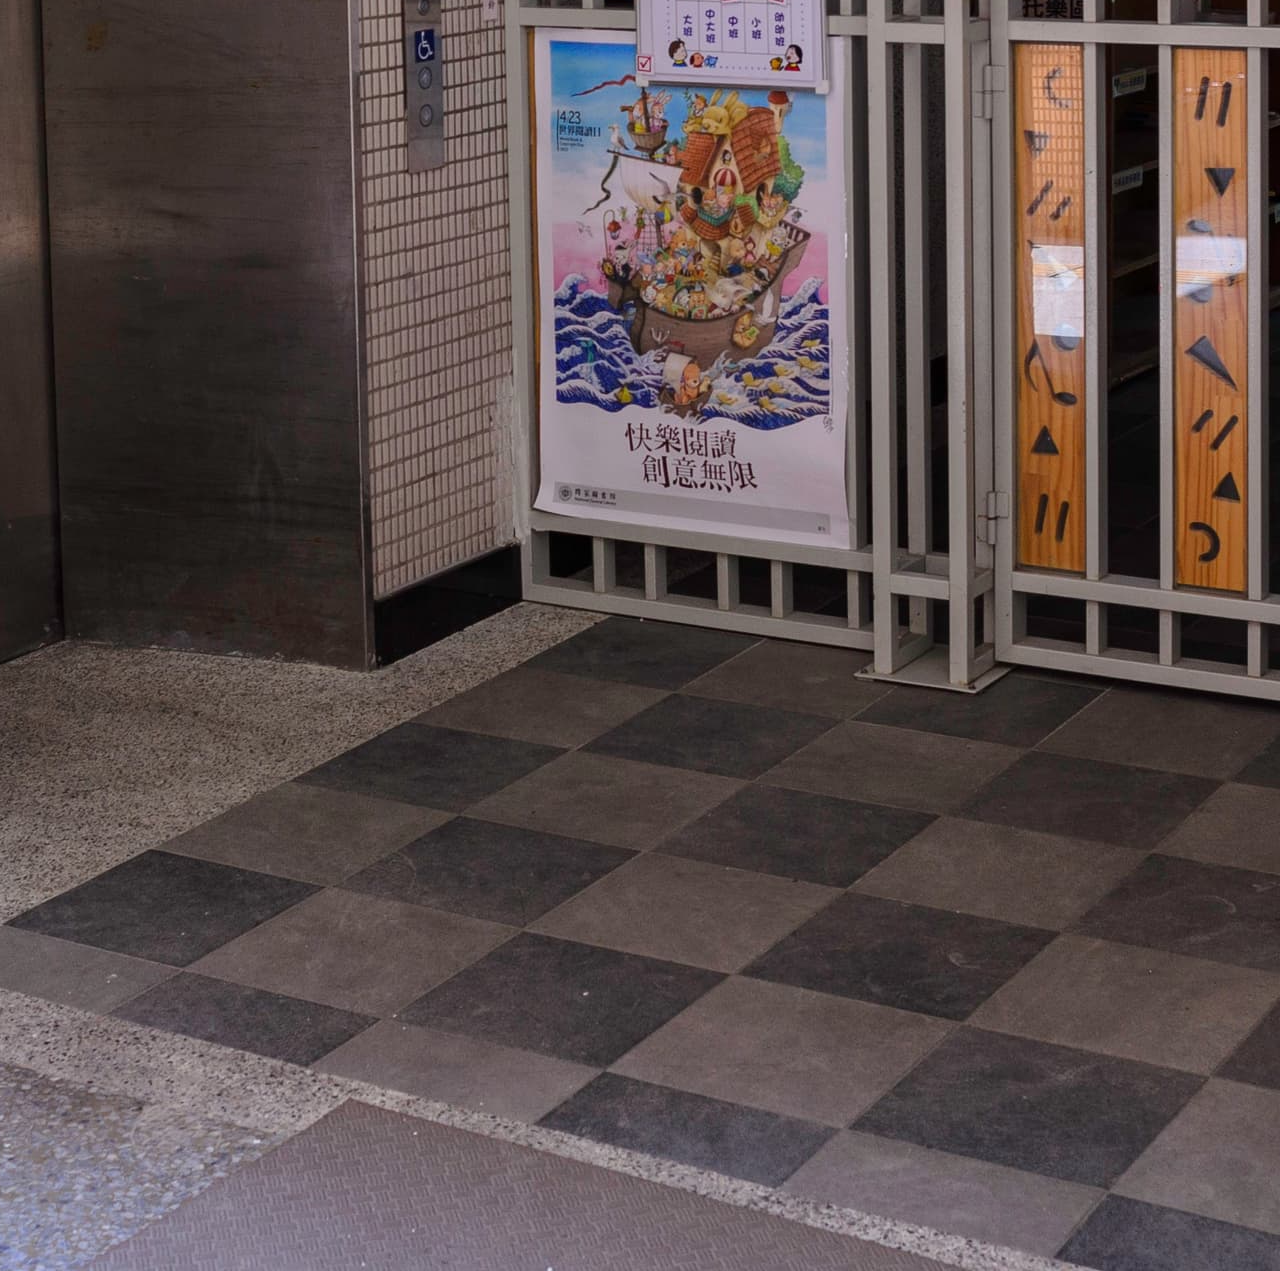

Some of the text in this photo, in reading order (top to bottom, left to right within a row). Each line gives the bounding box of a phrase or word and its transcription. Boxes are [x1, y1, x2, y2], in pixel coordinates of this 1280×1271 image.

[682, 14, 693, 37] 大班
[705, 9, 716, 43] 中大班
[728, 16, 738, 39] 中班
[751, 17, 762, 40] 小班
[624, 422, 737, 459] 快樂閱讀
[641, 454, 758, 494] 創意無限
